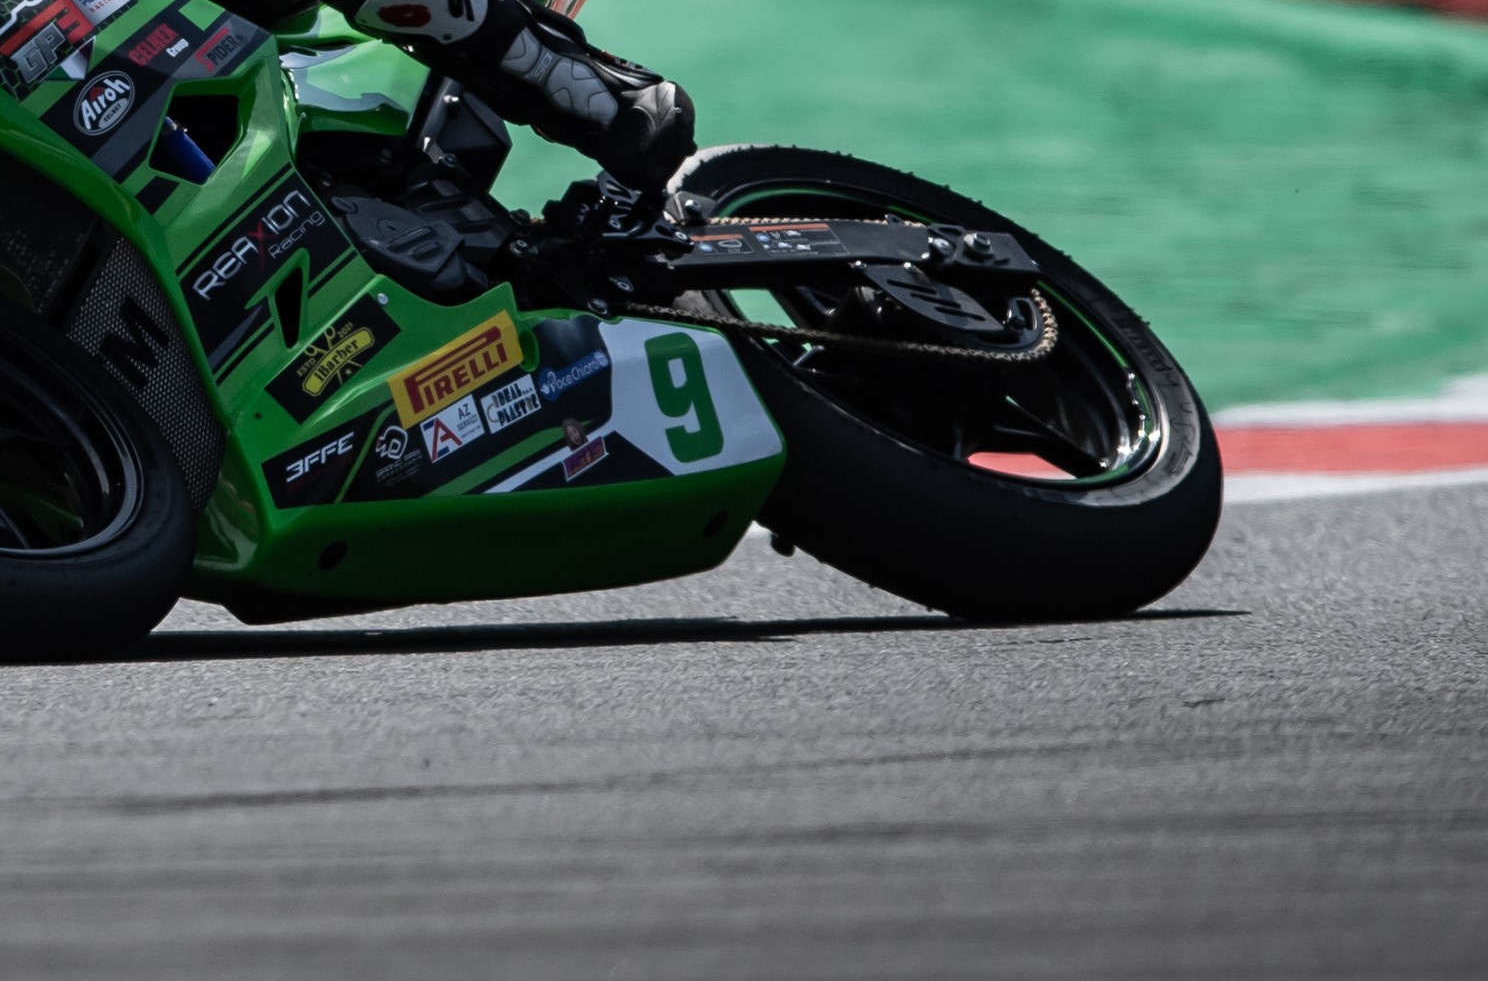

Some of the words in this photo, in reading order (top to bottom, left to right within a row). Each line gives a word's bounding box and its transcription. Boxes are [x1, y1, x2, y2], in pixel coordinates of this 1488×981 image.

[165, 38, 190, 58] Group
[80, 77, 131, 131] Airoh
[267, 210, 327, 260] Racing
[403, 325, 508, 415] PIRELLI
[644, 331, 725, 464] 9
